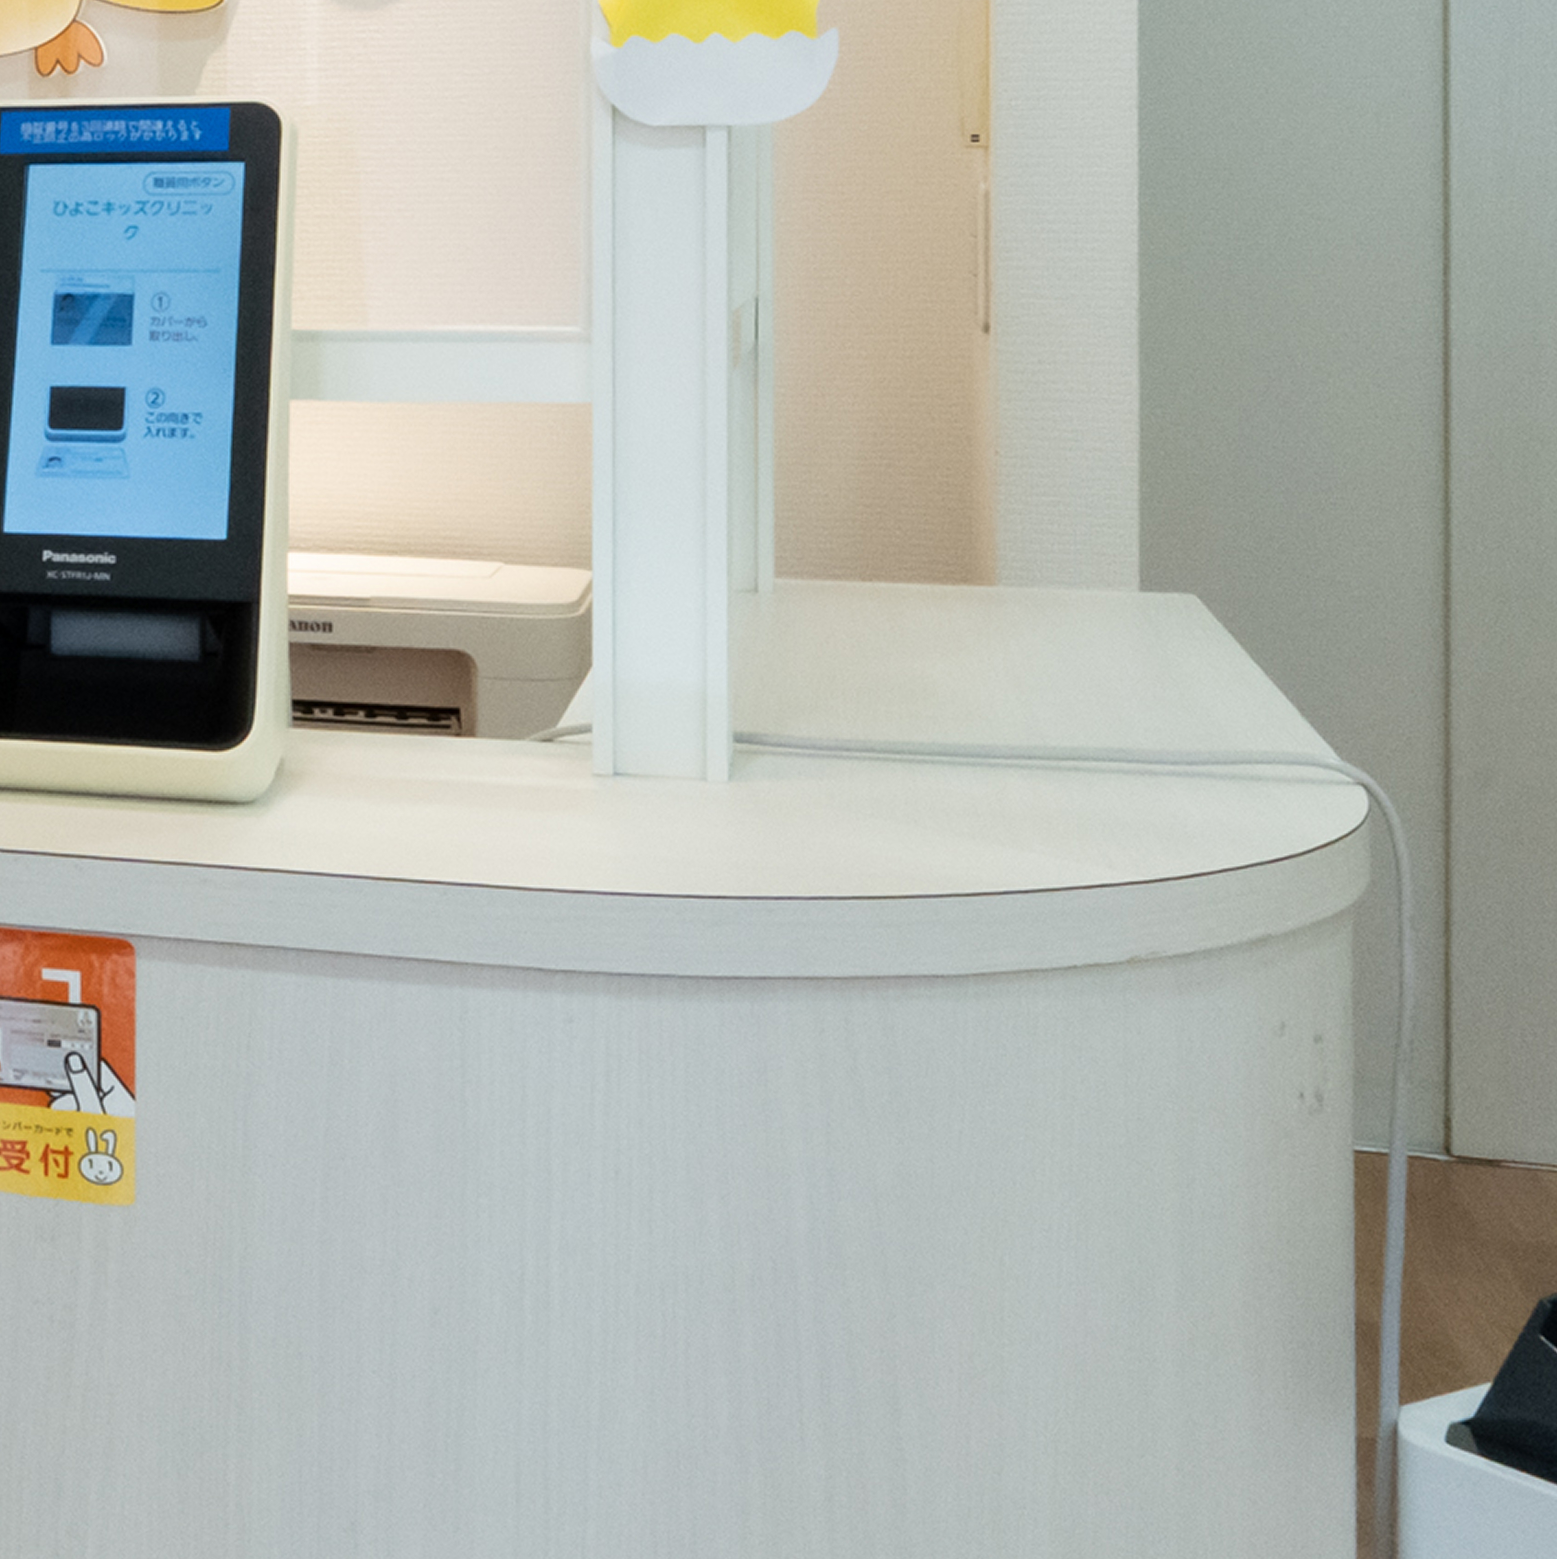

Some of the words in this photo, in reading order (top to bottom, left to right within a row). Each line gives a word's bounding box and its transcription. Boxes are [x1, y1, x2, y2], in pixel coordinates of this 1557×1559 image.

[52, 199, 214, 217] ひよこキッズクリニッ
[42, 549, 117, 564] Panasonic
[289, 619, 333, 634] anon
